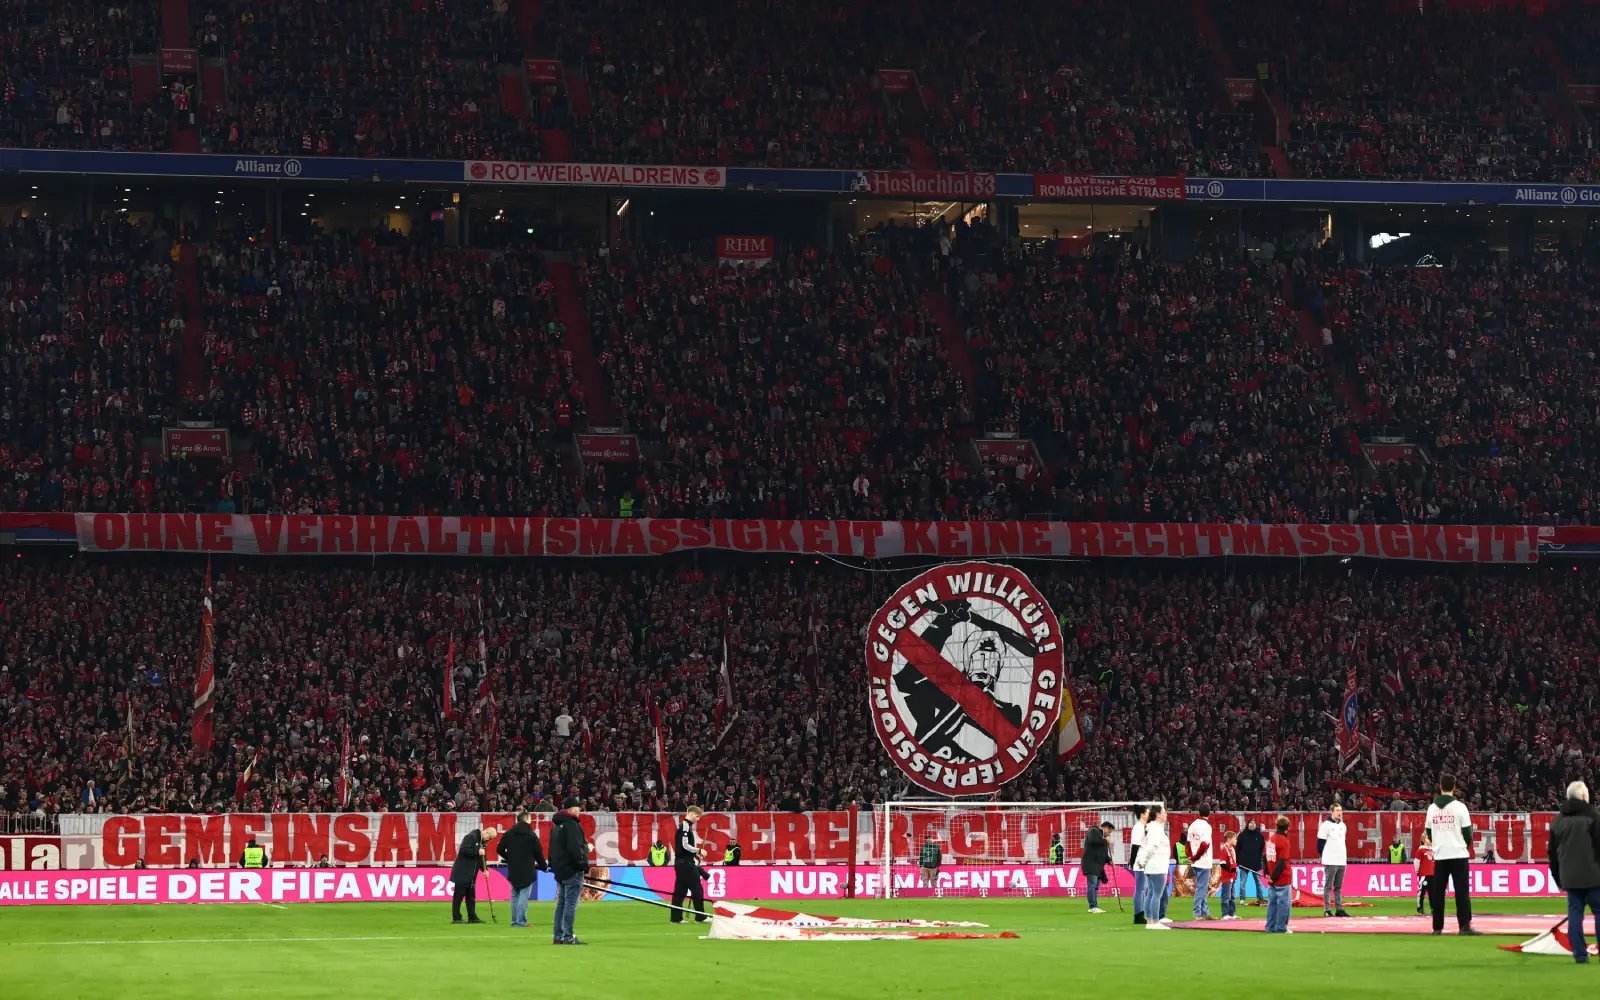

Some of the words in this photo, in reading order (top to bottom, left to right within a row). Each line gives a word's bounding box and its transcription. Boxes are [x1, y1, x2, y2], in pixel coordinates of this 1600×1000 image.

[235, 160, 282, 173] Allianz
[973, 174, 995, 195] 83
[1039, 184, 1126, 197] ROMANTISCHE
[1129, 185, 1182, 198] STRASSE
[1515, 188, 1558, 201] Allianz
[724, 238, 767, 252] RHM
[93, 513, 232, 551] OHNE
[249, 514, 884, 559] VERHÄLTNISMÄSSIGKEIT
[900, 520, 1052, 556] KEINE
[1067, 522, 1540, 562] RECHTMÄSSIGKEIT!
[873, 582, 939, 662] GEGEN
[946, 571, 1057, 653] WILLKÜR!
[1006, 669, 1057, 764] GEGEN
[102, 813, 457, 867] GEMEINSAM
[616, 812, 850, 862] UNSERE
[871, 811, 1101, 859] RECHTE
[0, 879, 49, 900] ALLE
[54, 875, 157, 900] SPIELE
[168, 871, 262, 900] DER
[272, 871, 361, 900] FIFA
[366, 873, 425, 898] WM
[770, 870, 838, 895] NUR
[894, 866, 1029, 888] MAGENTA
[1035, 867, 1079, 888] TV
[1367, 874, 1412, 893] ALLE
